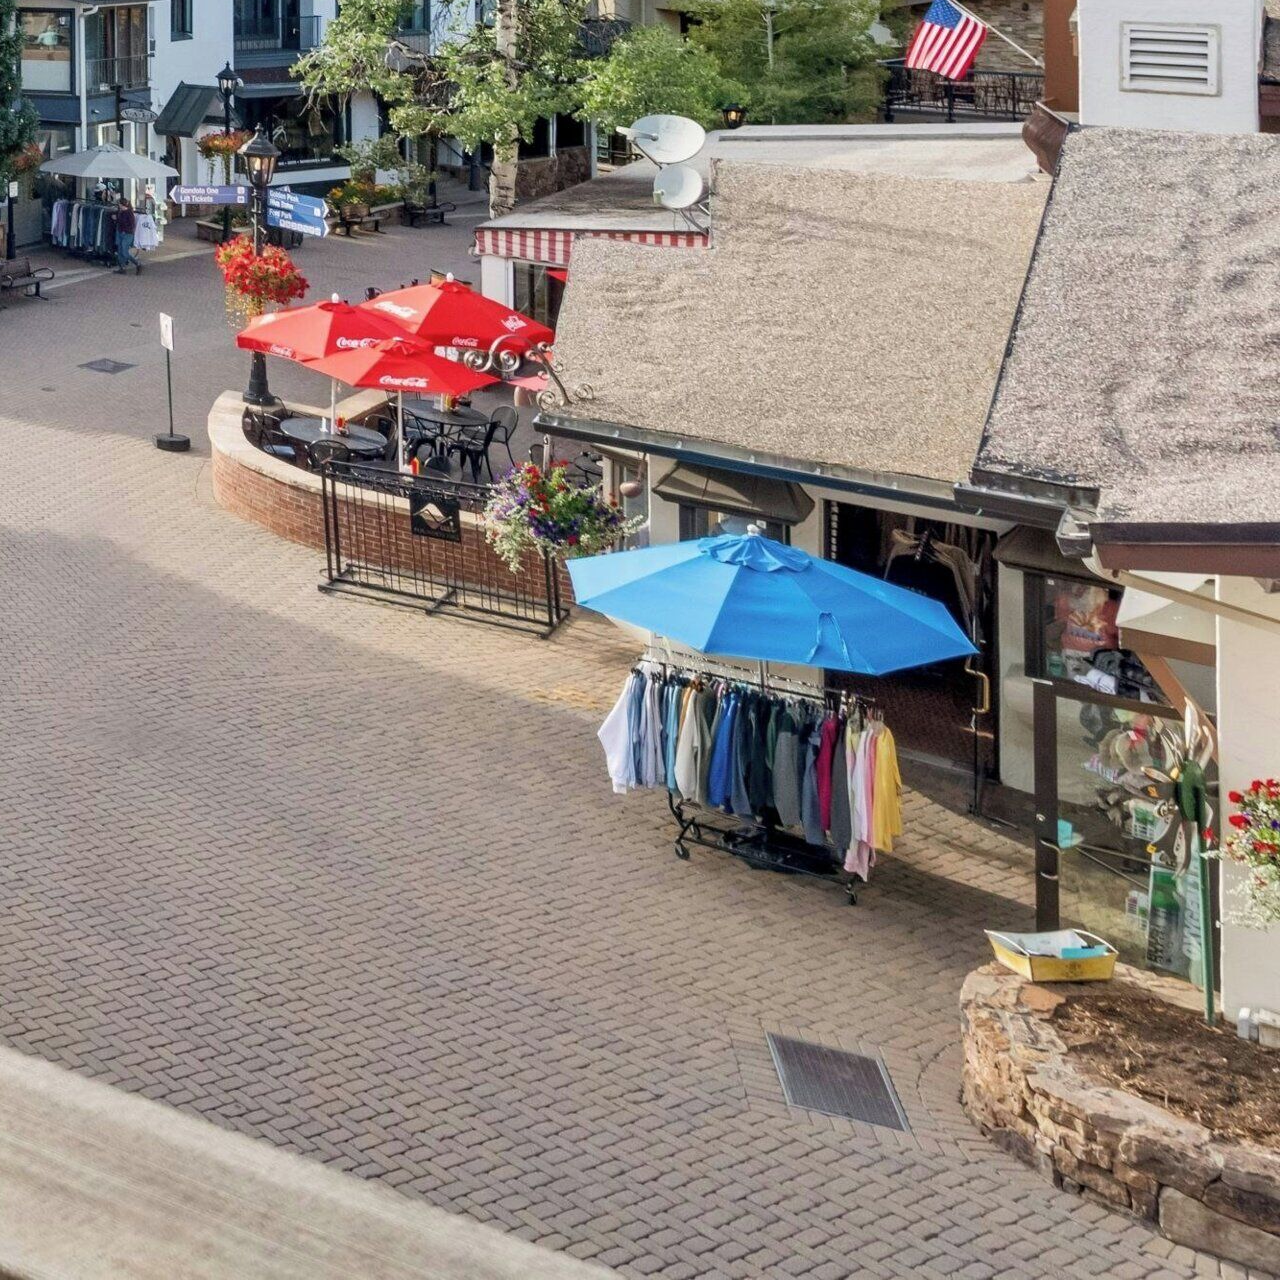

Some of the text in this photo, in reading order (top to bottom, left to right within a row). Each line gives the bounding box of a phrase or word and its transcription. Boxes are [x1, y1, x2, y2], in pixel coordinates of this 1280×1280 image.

[180, 186, 219, 194] Gondola One
[269, 190, 299, 202] Golden Peak
[379, 375, 428, 388] Coca-Cola
